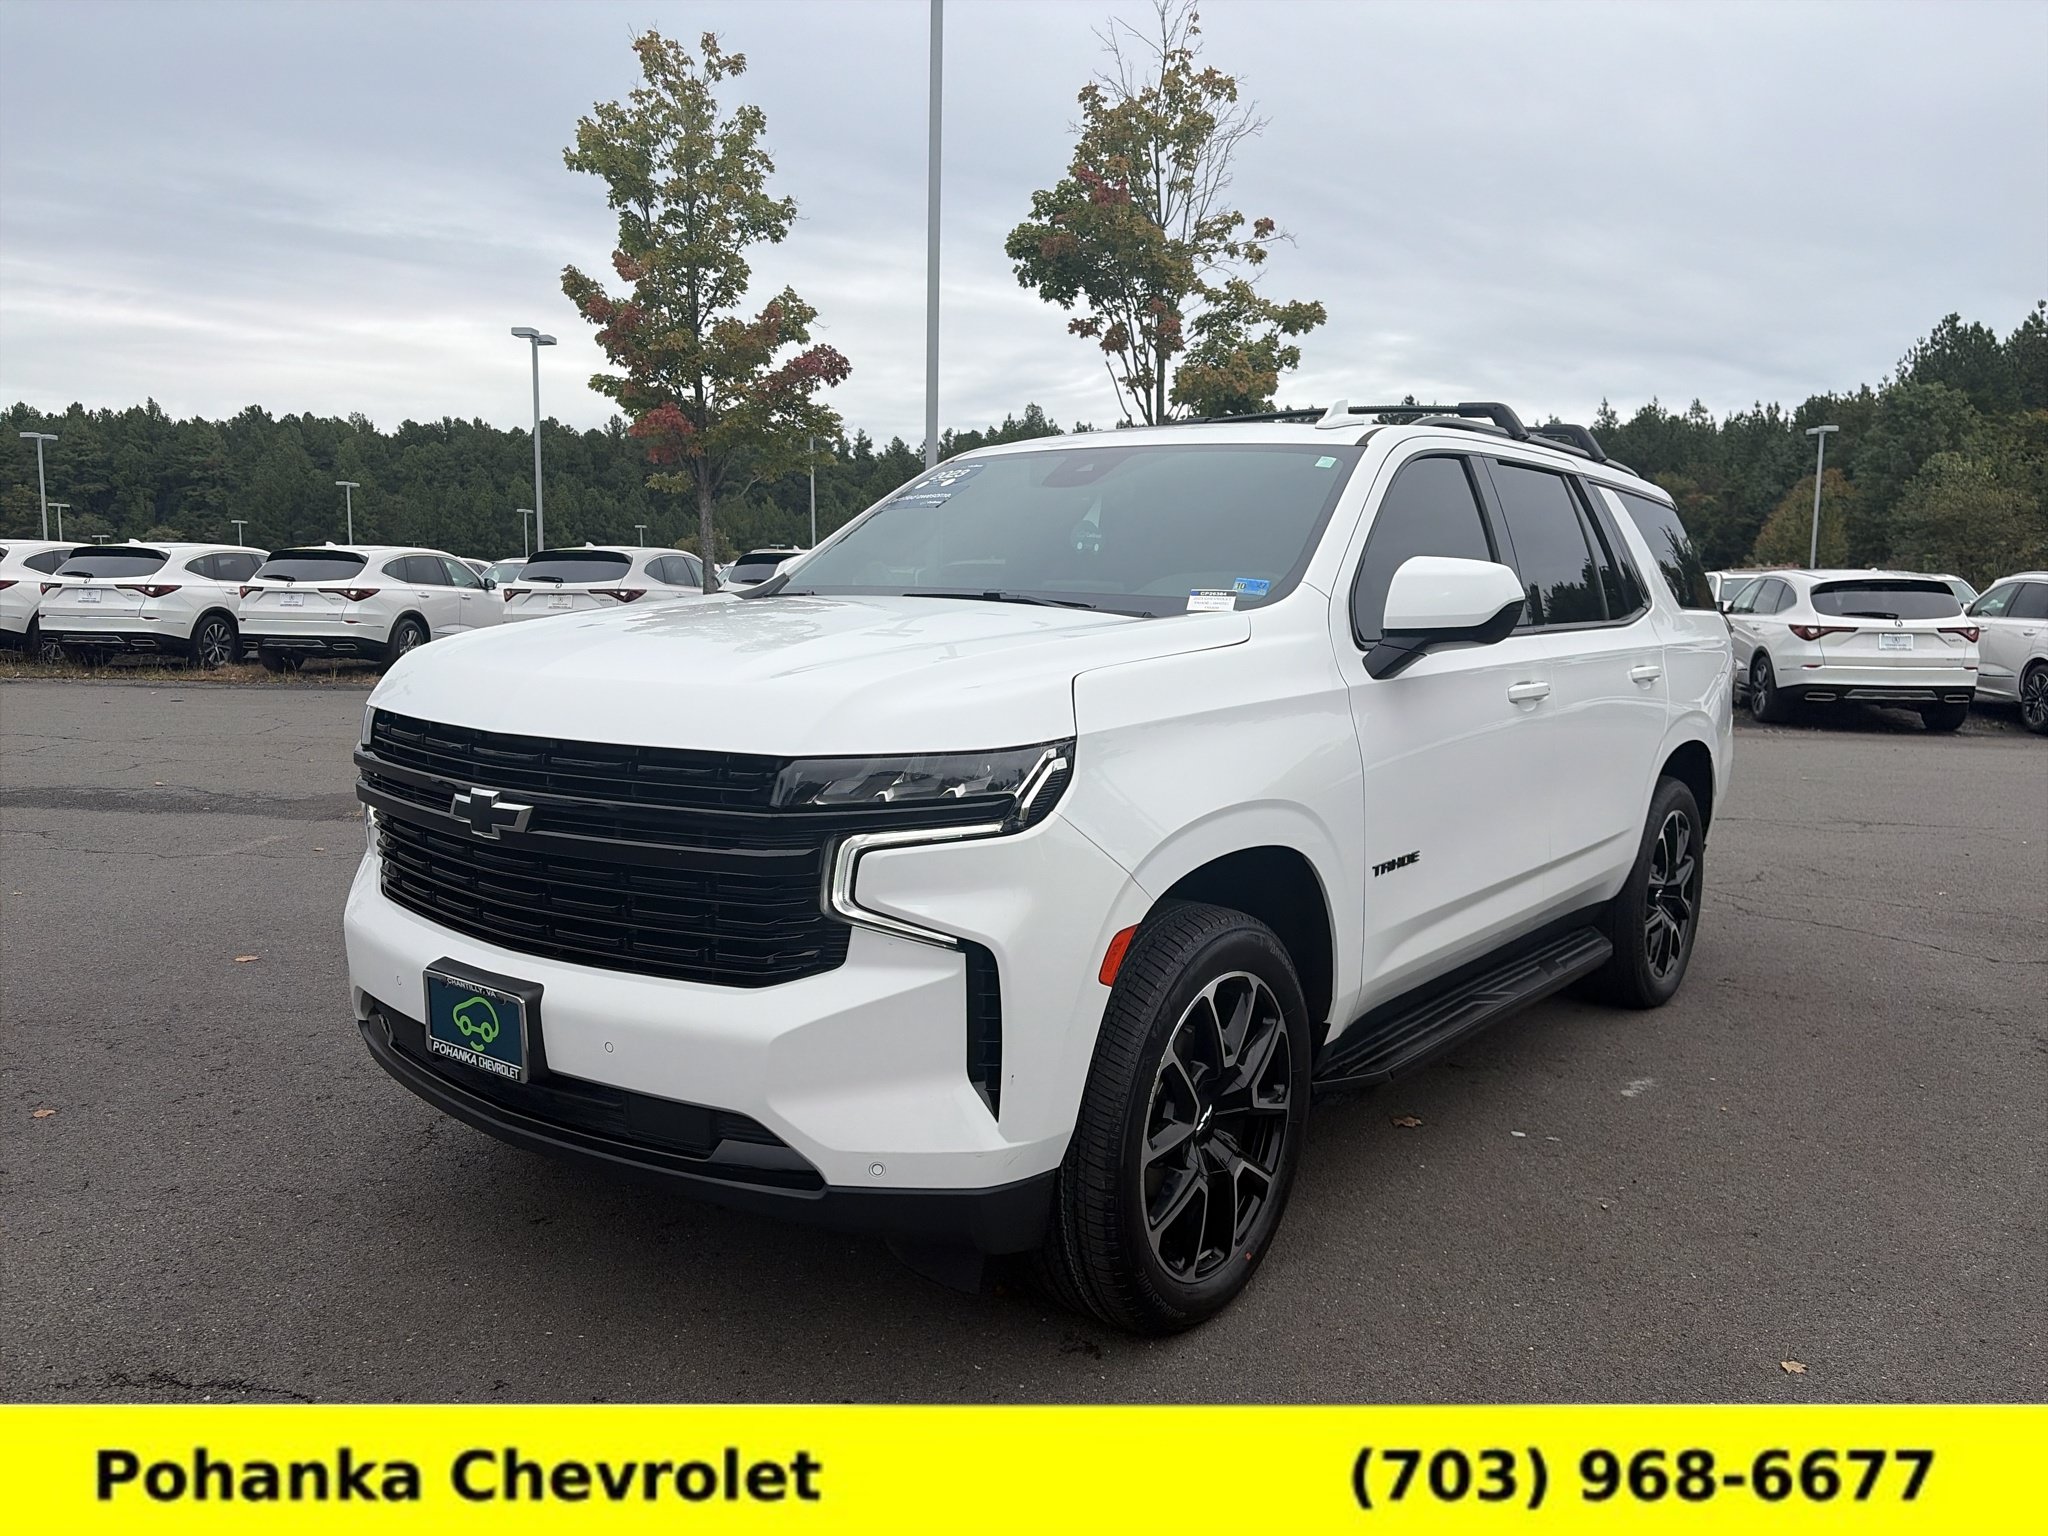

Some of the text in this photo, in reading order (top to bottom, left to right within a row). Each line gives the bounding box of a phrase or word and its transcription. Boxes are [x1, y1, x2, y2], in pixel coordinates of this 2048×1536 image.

[1372, 850, 1420, 877] TAHOE
[486, 989, 497, 998] VA
[433, 1041, 520, 1080] POHANKA CHEVROLET
